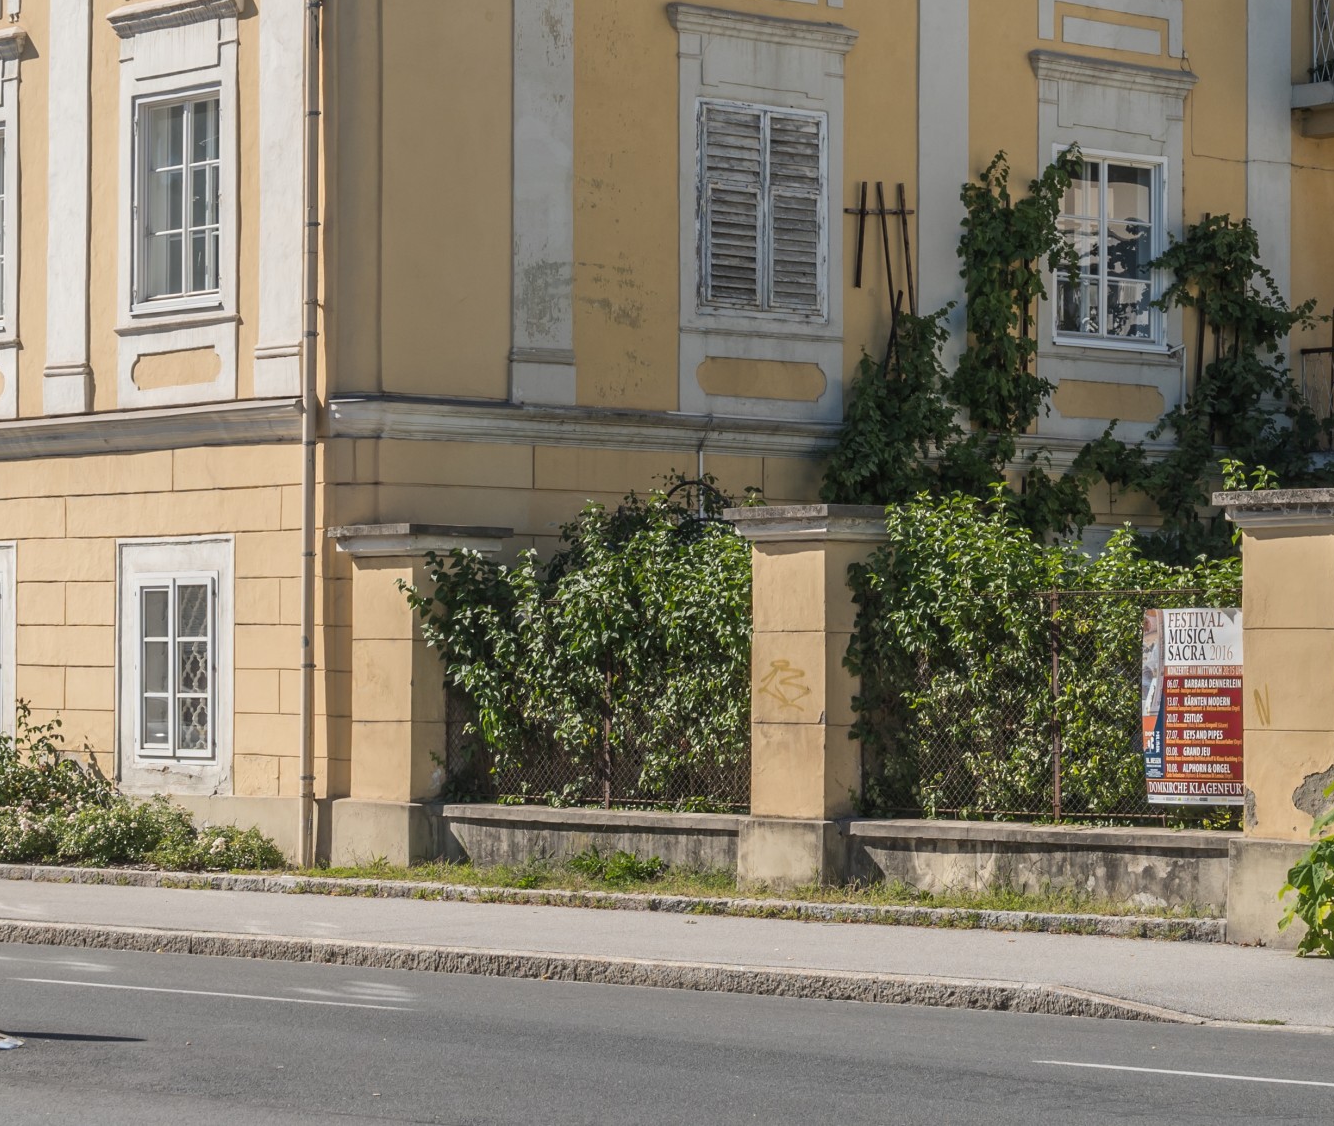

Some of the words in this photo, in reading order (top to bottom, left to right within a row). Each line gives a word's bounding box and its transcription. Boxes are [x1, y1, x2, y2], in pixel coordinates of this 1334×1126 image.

[1168, 612, 1224, 628] FESTIVAL
[1168, 628, 1216, 644] MUSICA
[1168, 644, 1206, 661] SACRA
[1210, 644, 1234, 660] 2016
[1168, 666, 1189, 674] KONZERTE
[1198, 666, 1222, 674] MITTWOCH
[1167, 680, 1180, 688] 06.07.
[1184, 678, 1208, 688] BARBARA
[1209, 678, 1242, 688] DENNERLEIN
[1167, 696, 1180, 706] 13.07.
[1184, 695, 1207, 706] KÄRNTEN
[1208, 696, 1230, 706] MODERN
[1184, 714, 1204, 722] ZEITLOS
[1166, 730, 1179, 739] 27.07.
[1184, 730, 1196, 739] KEYS
[1196, 730, 1207, 739] AND
[1208, 730, 1223, 739] PIPES
[1183, 746, 1200, 756] GRAND
[1201, 746, 1211, 756] JEU
[1182, 764, 1207, 773] ALPHORN
[1208, 764, 1212, 773] &
[1213, 764, 1230, 773] ORGEL
[1148, 782, 1188, 793] DOMKIRCHE
